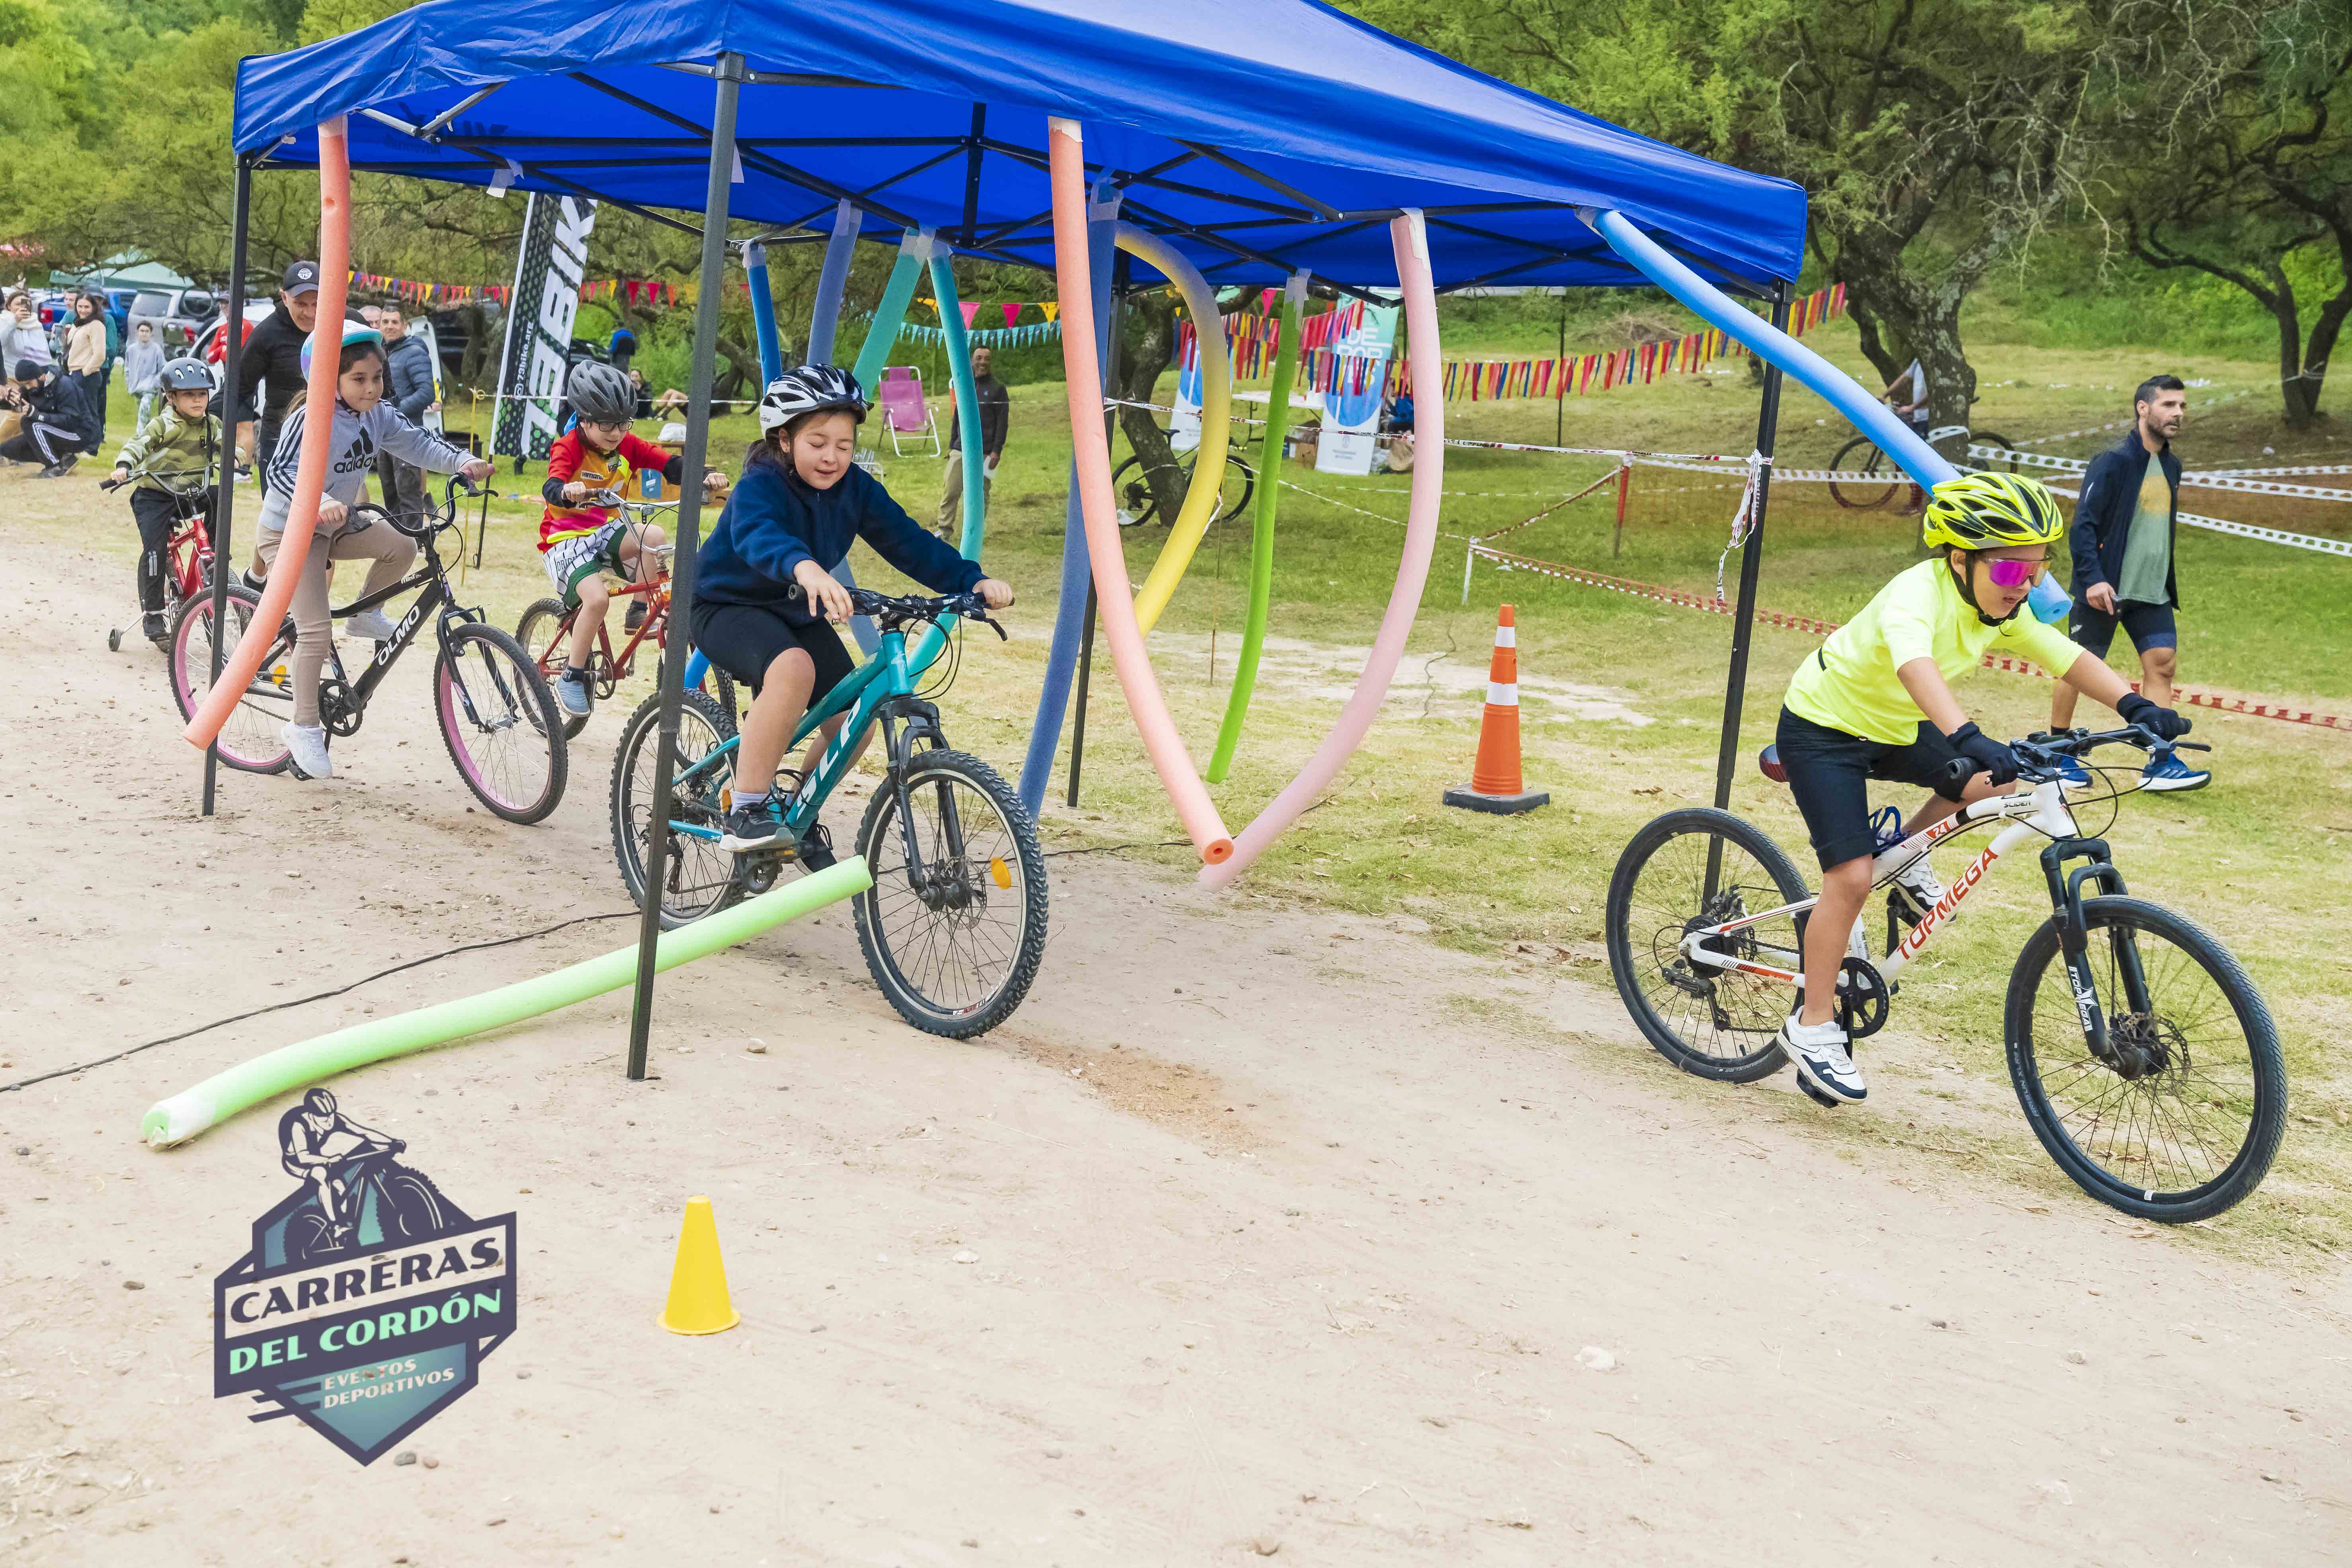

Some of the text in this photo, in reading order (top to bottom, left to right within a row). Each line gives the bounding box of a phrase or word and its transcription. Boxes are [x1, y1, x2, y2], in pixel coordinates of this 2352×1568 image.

[1347, 327, 1392, 348] DE
[378, 605, 420, 666] OLMO
[1896, 847, 1999, 960] TOPMEGA
